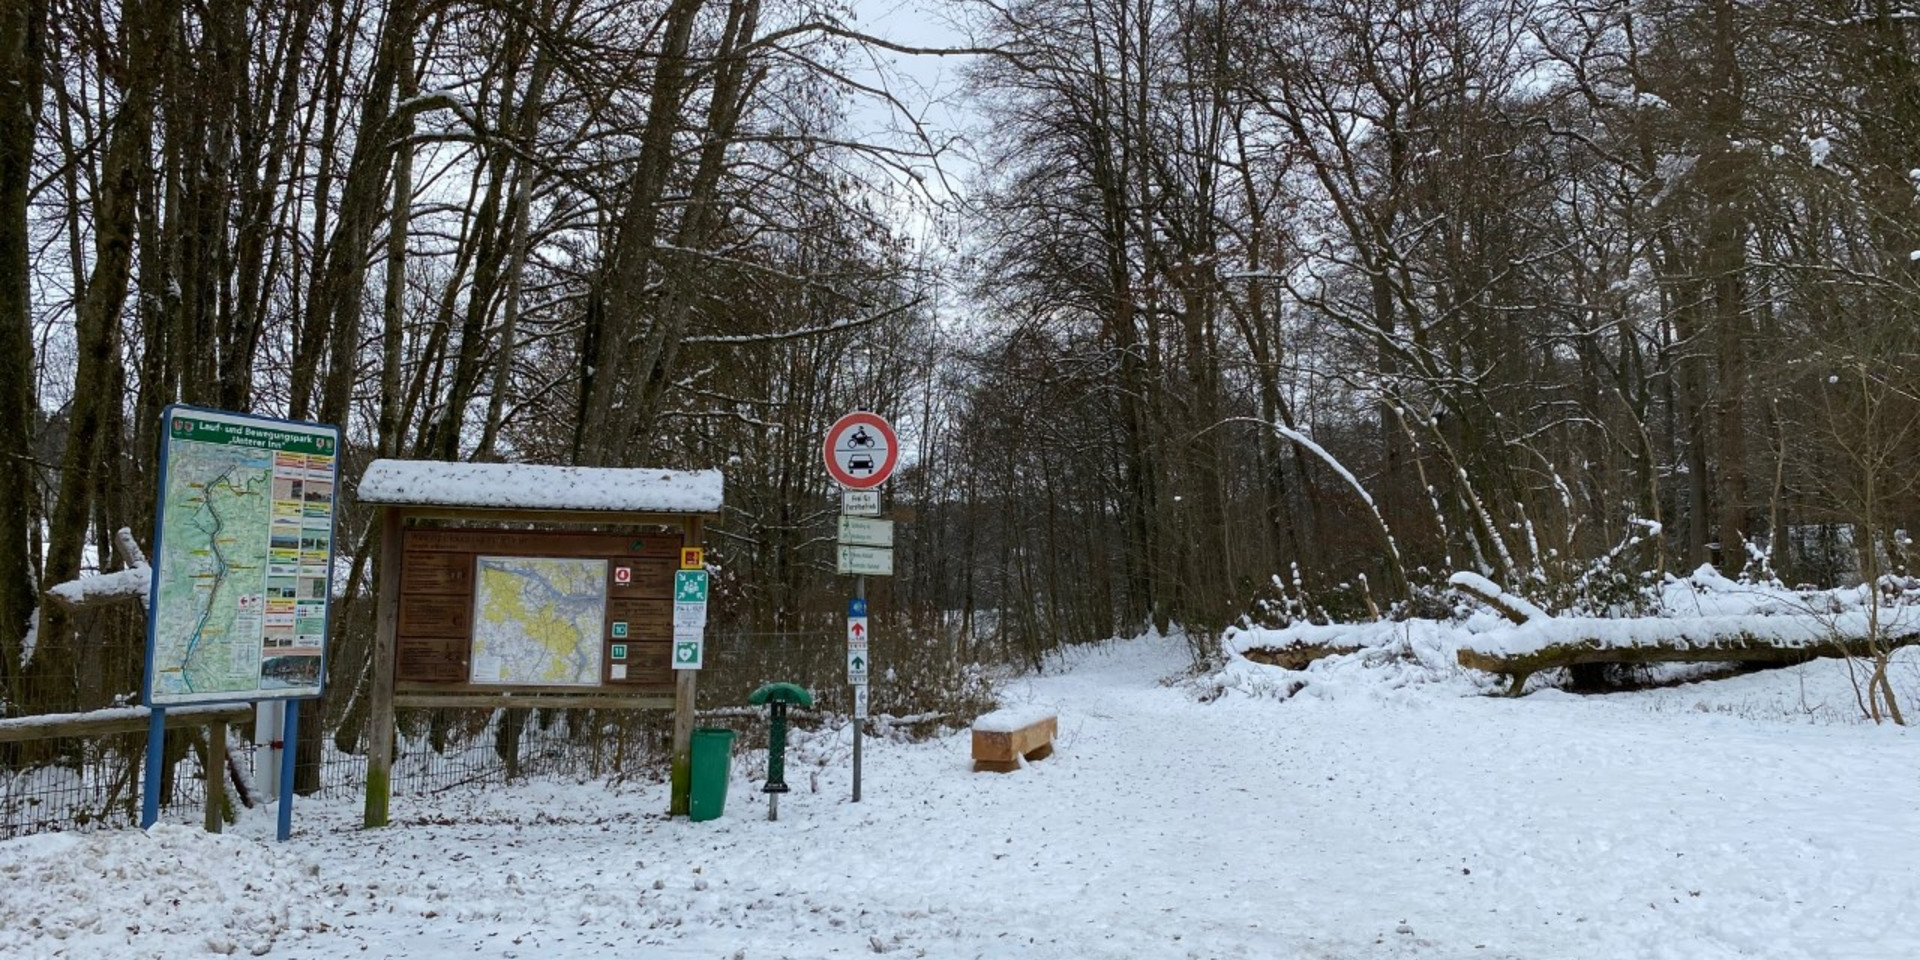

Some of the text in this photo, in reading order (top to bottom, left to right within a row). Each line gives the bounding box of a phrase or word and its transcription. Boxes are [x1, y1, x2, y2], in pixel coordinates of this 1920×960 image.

[199, 421, 313, 443] Lauf- und Bewegungspark
[615, 626, 625, 634] 10
